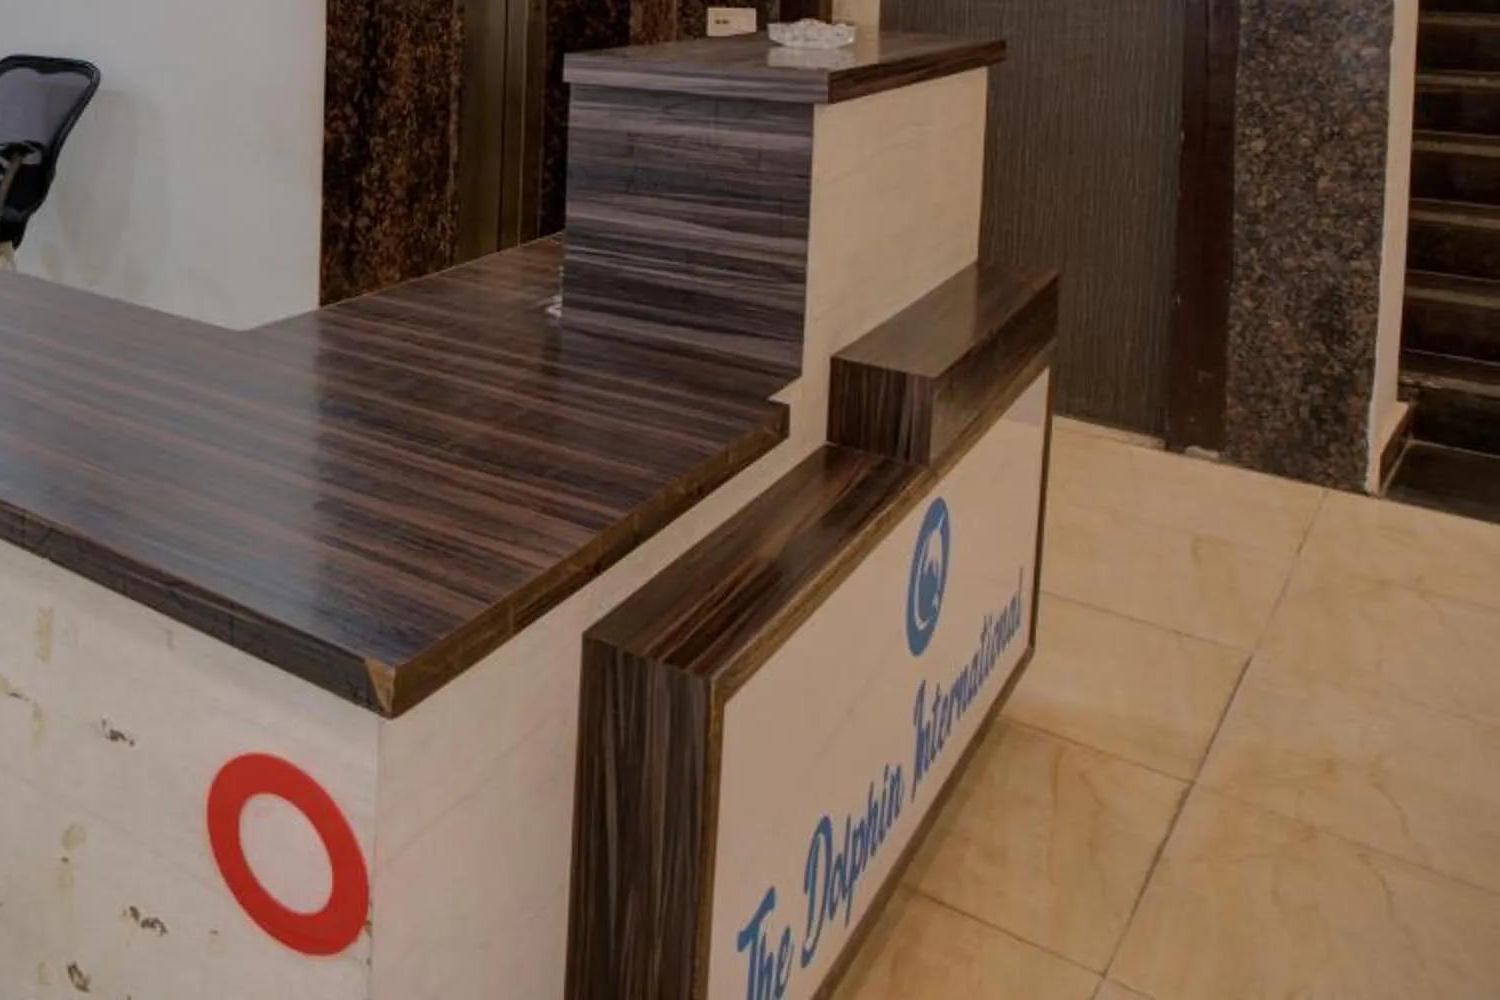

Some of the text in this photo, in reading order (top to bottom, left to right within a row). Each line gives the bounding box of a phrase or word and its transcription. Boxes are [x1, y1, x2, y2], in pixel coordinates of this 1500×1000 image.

[737, 565, 1025, 1000] The Dolphin International
